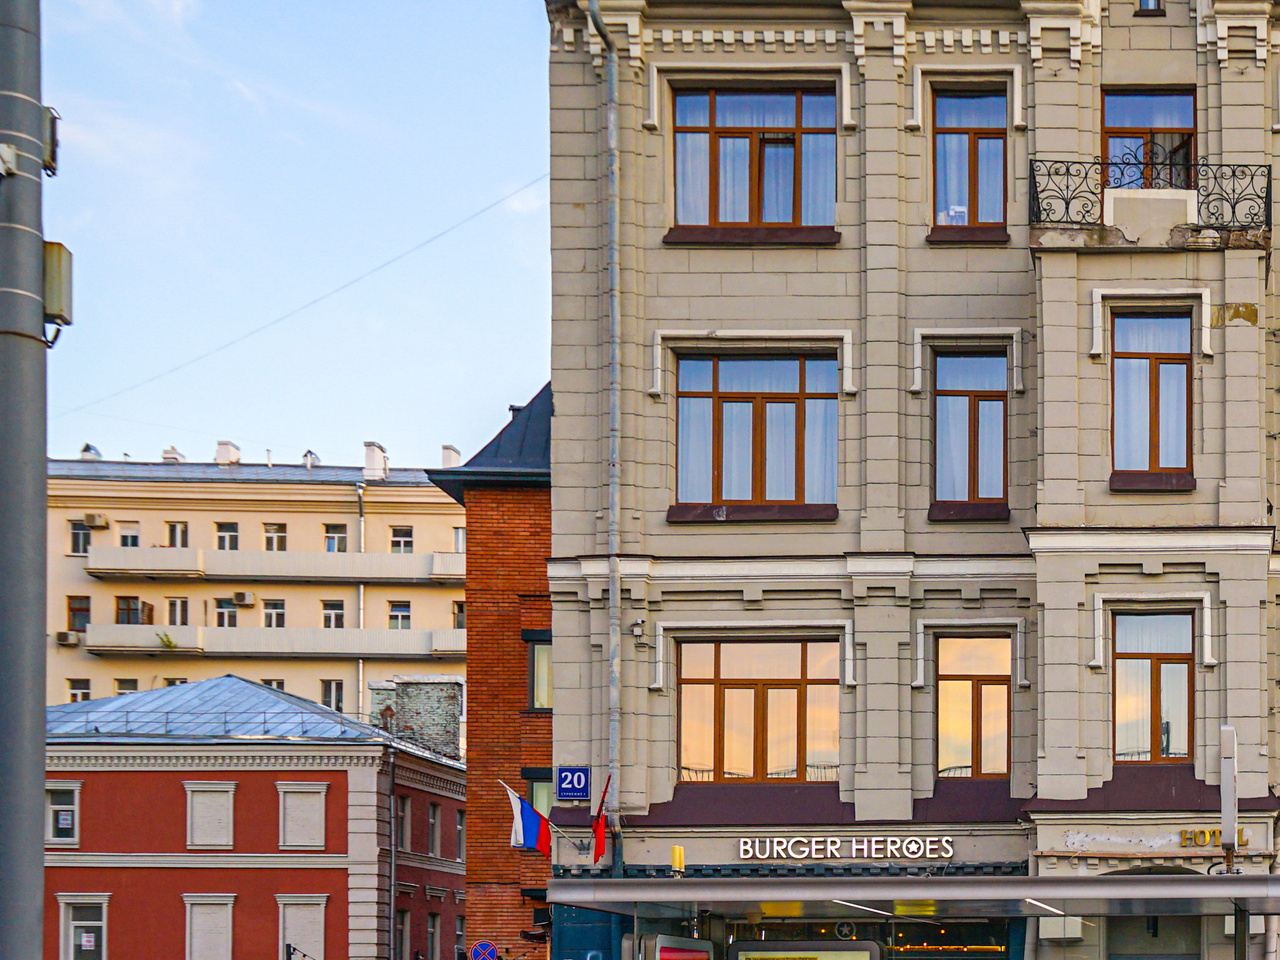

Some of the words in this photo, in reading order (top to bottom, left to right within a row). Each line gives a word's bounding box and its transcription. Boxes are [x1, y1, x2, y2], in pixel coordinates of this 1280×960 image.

[561, 771, 586, 789] 20
[1180, 827, 1249, 847] HOTL
[739, 837, 841, 860] BURGER
[851, 836, 954, 860] HEROES
